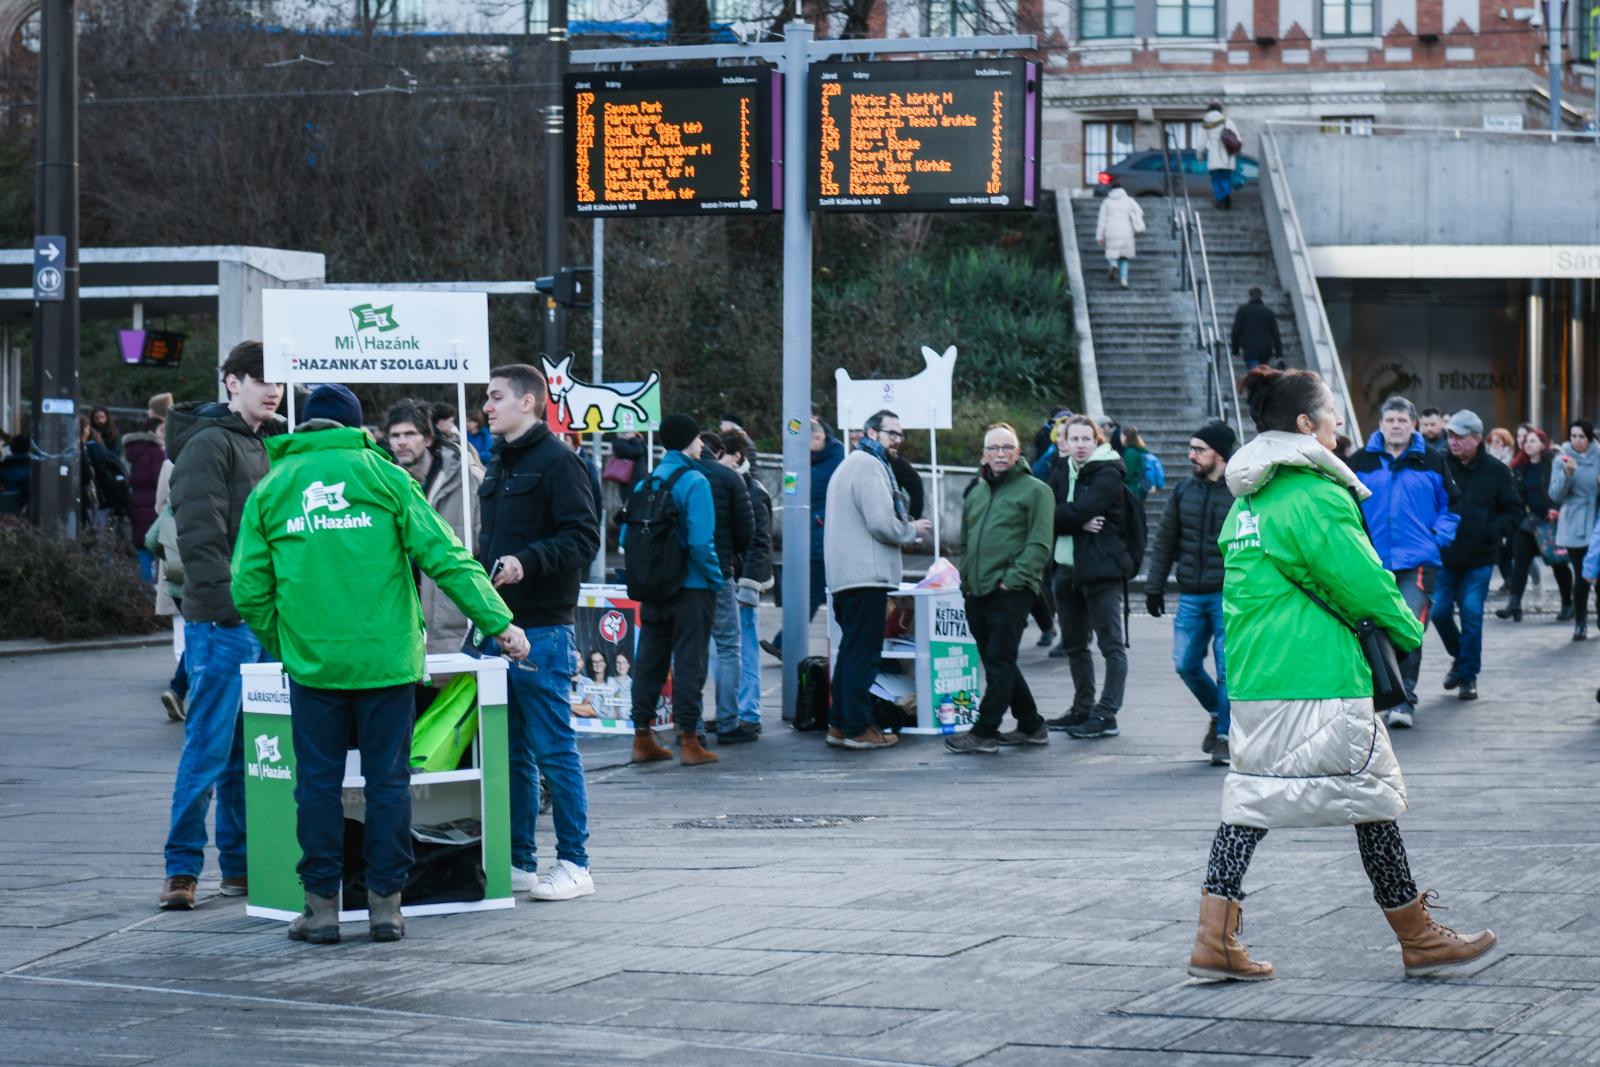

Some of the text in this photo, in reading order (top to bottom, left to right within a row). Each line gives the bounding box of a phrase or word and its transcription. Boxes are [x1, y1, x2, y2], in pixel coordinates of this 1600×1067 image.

[641, 101, 662, 113] Park
[336, 336, 420, 350] Mi Hazánk
[286, 512, 372, 534] Mi Hazánk
[935, 620, 967, 638] KUTYA
[248, 763, 292, 780] Mi Hazánk
